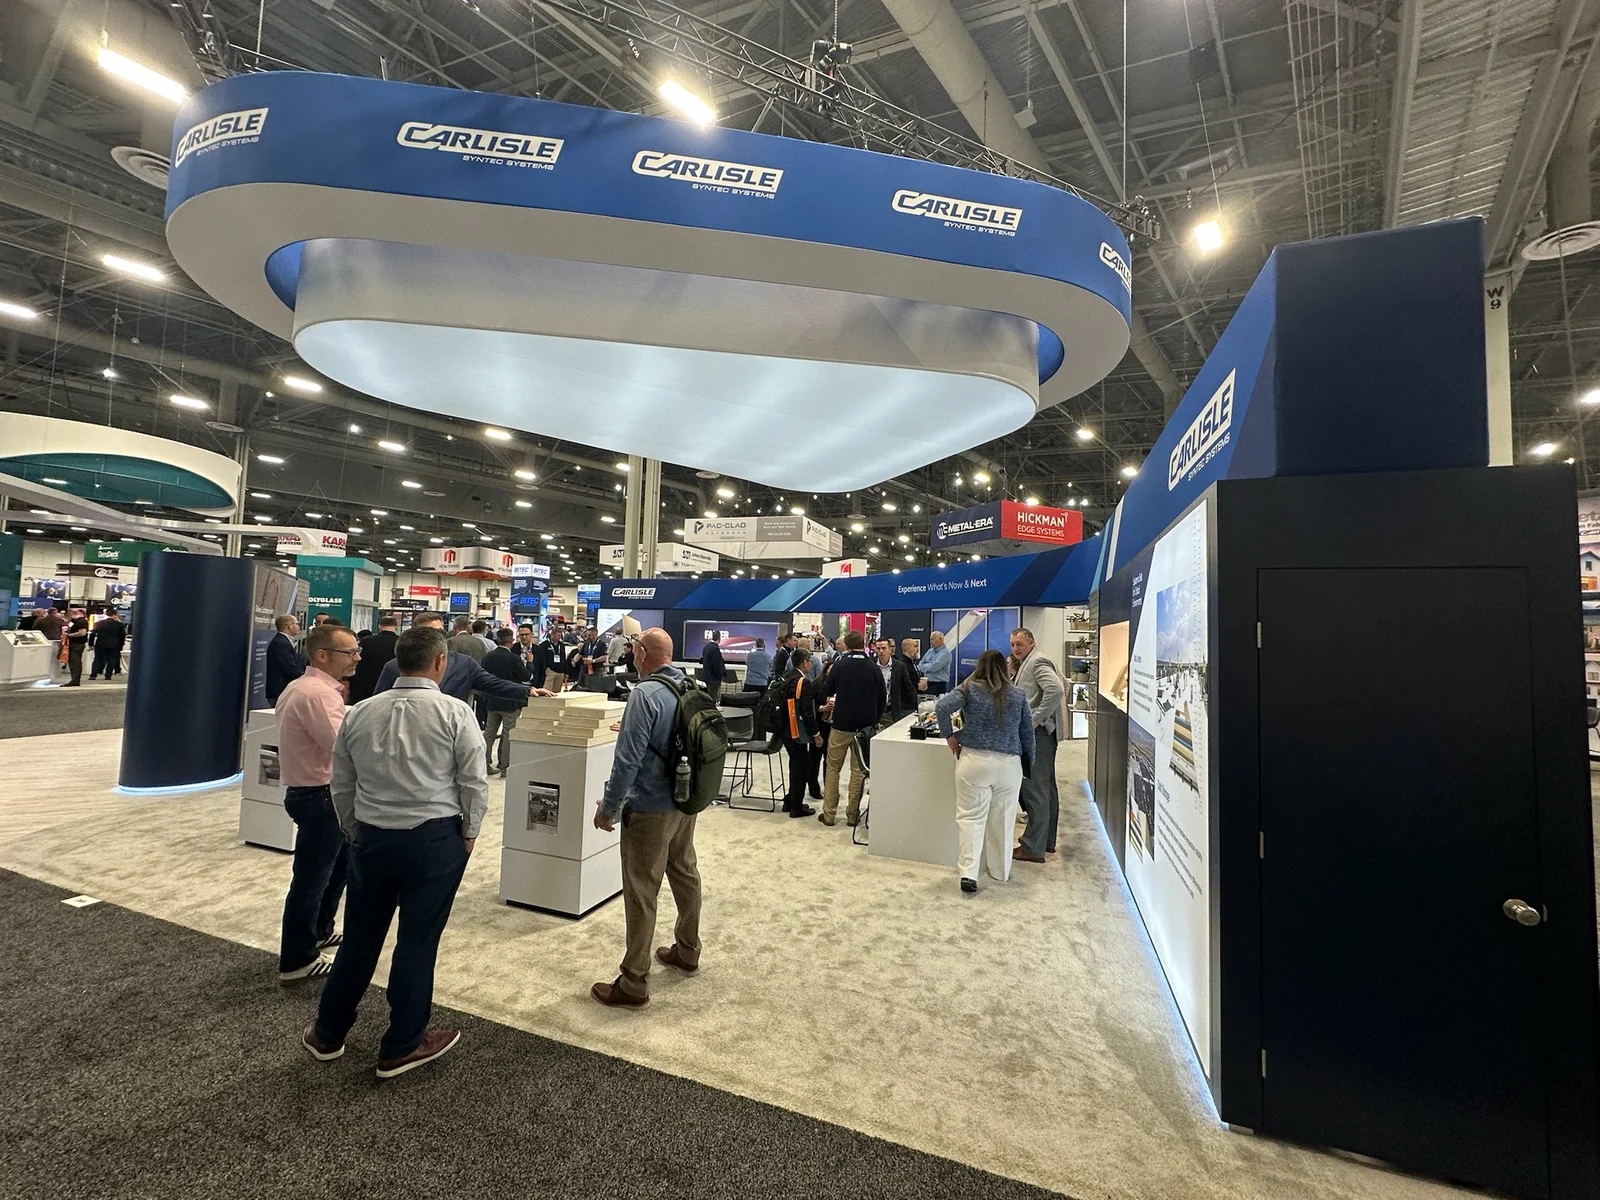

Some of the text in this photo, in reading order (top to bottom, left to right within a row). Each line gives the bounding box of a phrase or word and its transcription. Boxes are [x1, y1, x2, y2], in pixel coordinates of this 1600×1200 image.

[176, 112, 263, 163] CARLISLE
[221, 137, 259, 147] SYSTEMS
[402, 125, 558, 159] CARLISLE
[462, 154, 555, 171] SYNTEC SYSTEMS
[637, 154, 778, 188] CARLISLE
[691, 183, 776, 199] SYNTEC SYSTEMS
[897, 193, 1018, 227] CARLISLE
[943, 221, 1017, 237] SYNTEC SYSTEMS
[1486, 285, 1504, 298] W
[1169, 382, 1233, 484] CARLISLE
[1204, 431, 1231, 464] SYSTEMS
[1017, 511, 1065, 528] HICKMAN
[1017, 524, 1065, 538] EDGE SYSTEMS
[613, 588, 655, 597] CARLISLE
[897, 578, 987, 595] Experience What's Now & Next
[704, 629, 730, 640] FAER
